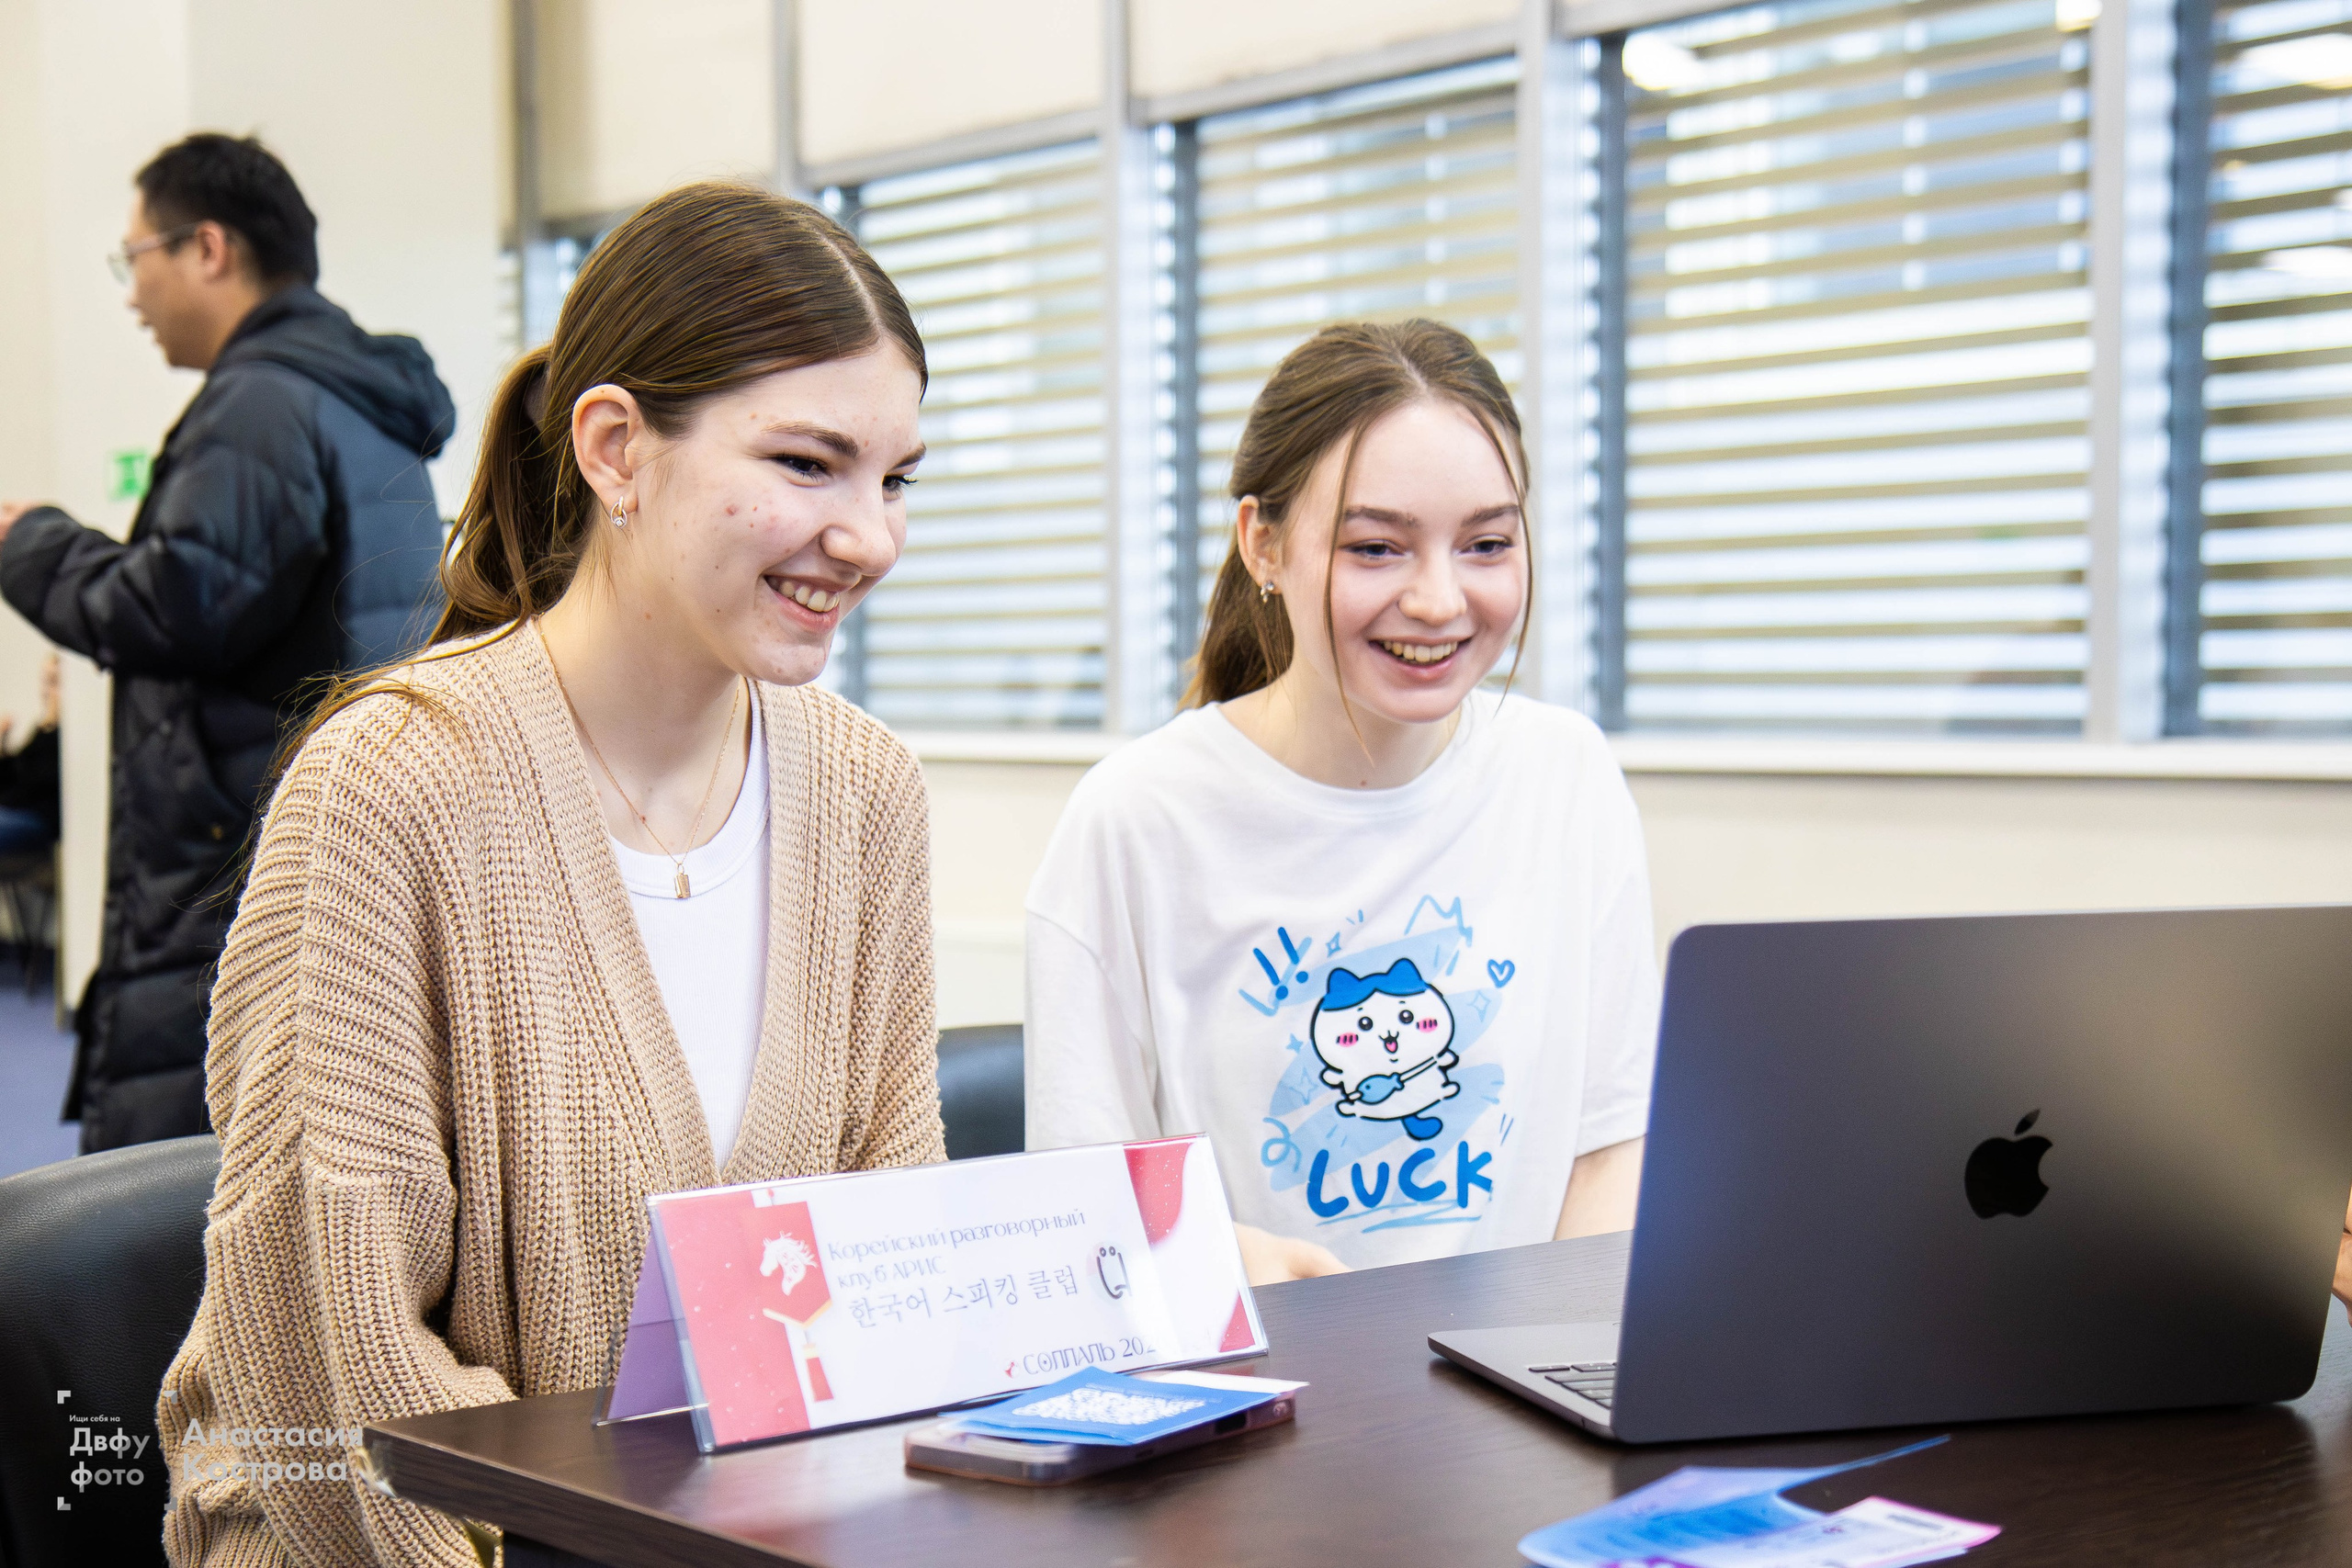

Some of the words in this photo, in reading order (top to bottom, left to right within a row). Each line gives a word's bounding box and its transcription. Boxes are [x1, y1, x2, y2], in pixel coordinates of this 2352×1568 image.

[1306, 1140, 1493, 1218] LUCK
[828, 1228, 947, 1263] Корейский
[949, 1208, 1087, 1250] разговорный
[837, 1264, 888, 1291] клуб
[892, 1256, 947, 1282] АРИС
[848, 1287, 933, 1329] 한국어
[942, 1273, 1019, 1314] 스피킹
[1027, 1264, 1079, 1301] 클럽
